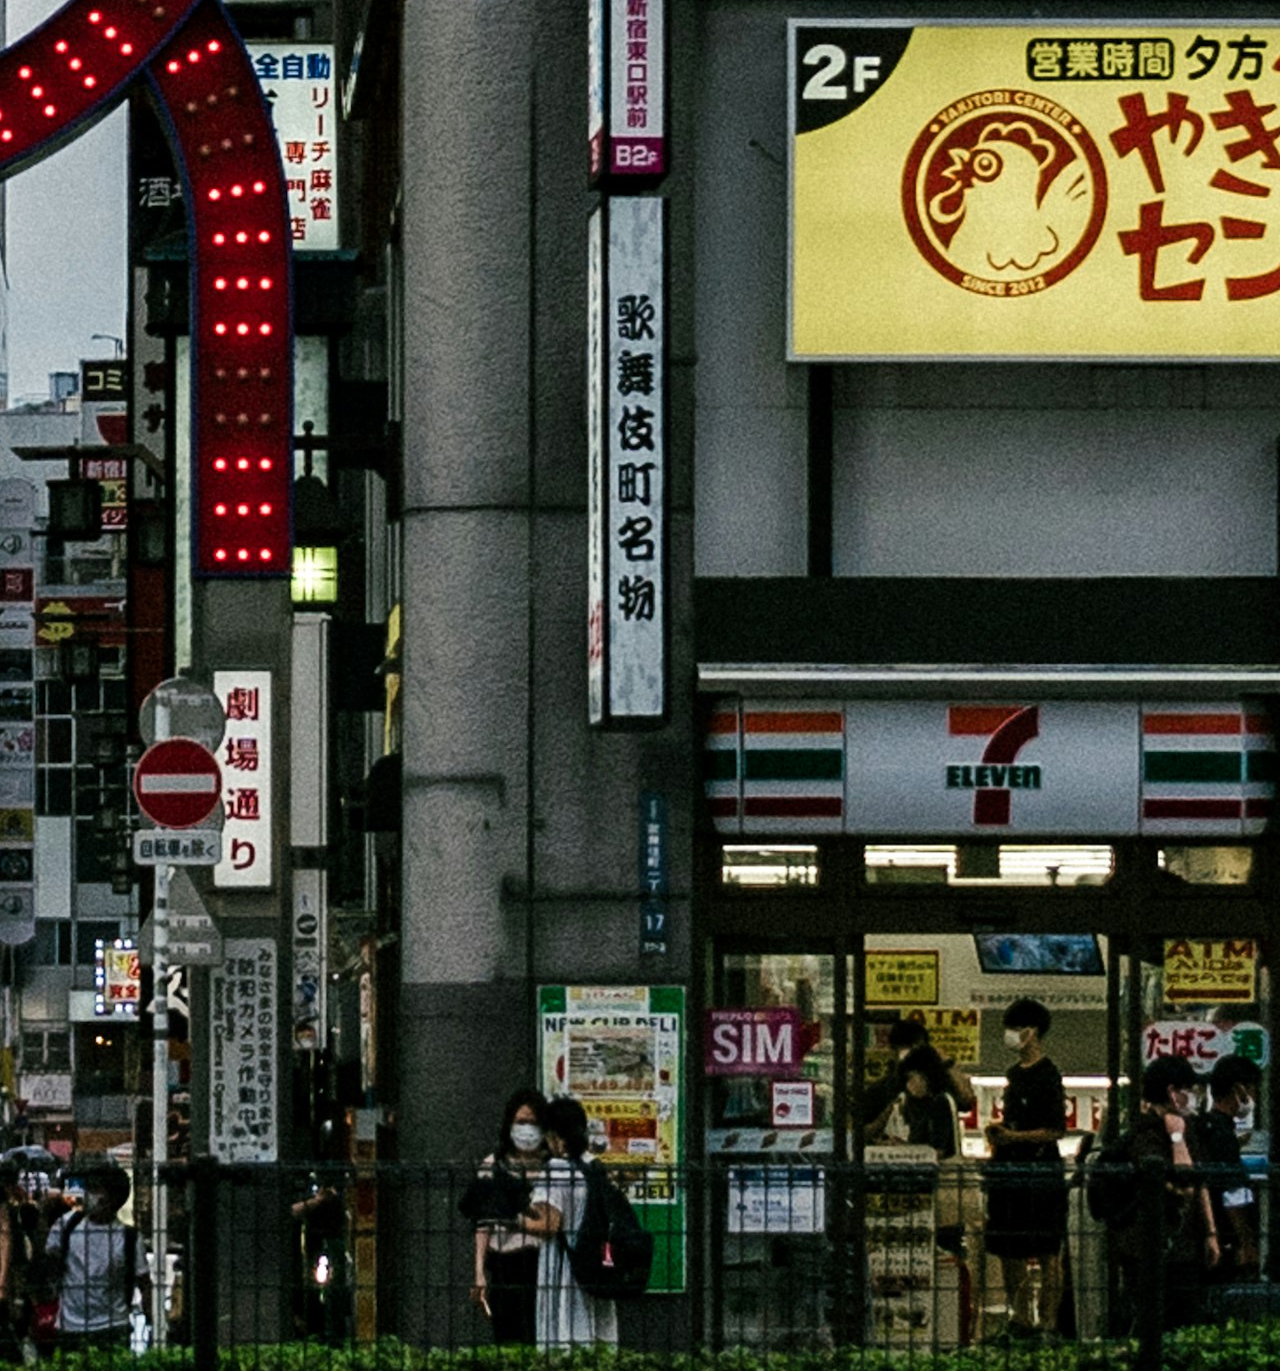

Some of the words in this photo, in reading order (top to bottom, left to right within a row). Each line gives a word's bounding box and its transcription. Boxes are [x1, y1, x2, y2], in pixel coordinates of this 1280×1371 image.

[802, 44, 881, 100] 2F
[1031, 41, 1172, 78] 営業時間
[940, 91, 1011, 124] YAKITORI
[1014, 91, 1073, 125] CENTER
[309, 87, 332, 222] リーチ麻雀
[615, 145, 659, 168] B2F
[960, 273, 1007, 296] SINCE
[617, 296, 655, 622] 歌舞伎町名物
[225, 687, 261, 871] 劇場通り
[139, 839, 218, 858] 自転車を除く
[1167, 939, 1255, 959] ATM
[906, 1009, 978, 1026] ATM
[237, 958, 257, 1122] 防犯カメラ作動中
[712, 1023, 793, 1064] SIM
[1146, 1028, 1218, 1060] たばこ
